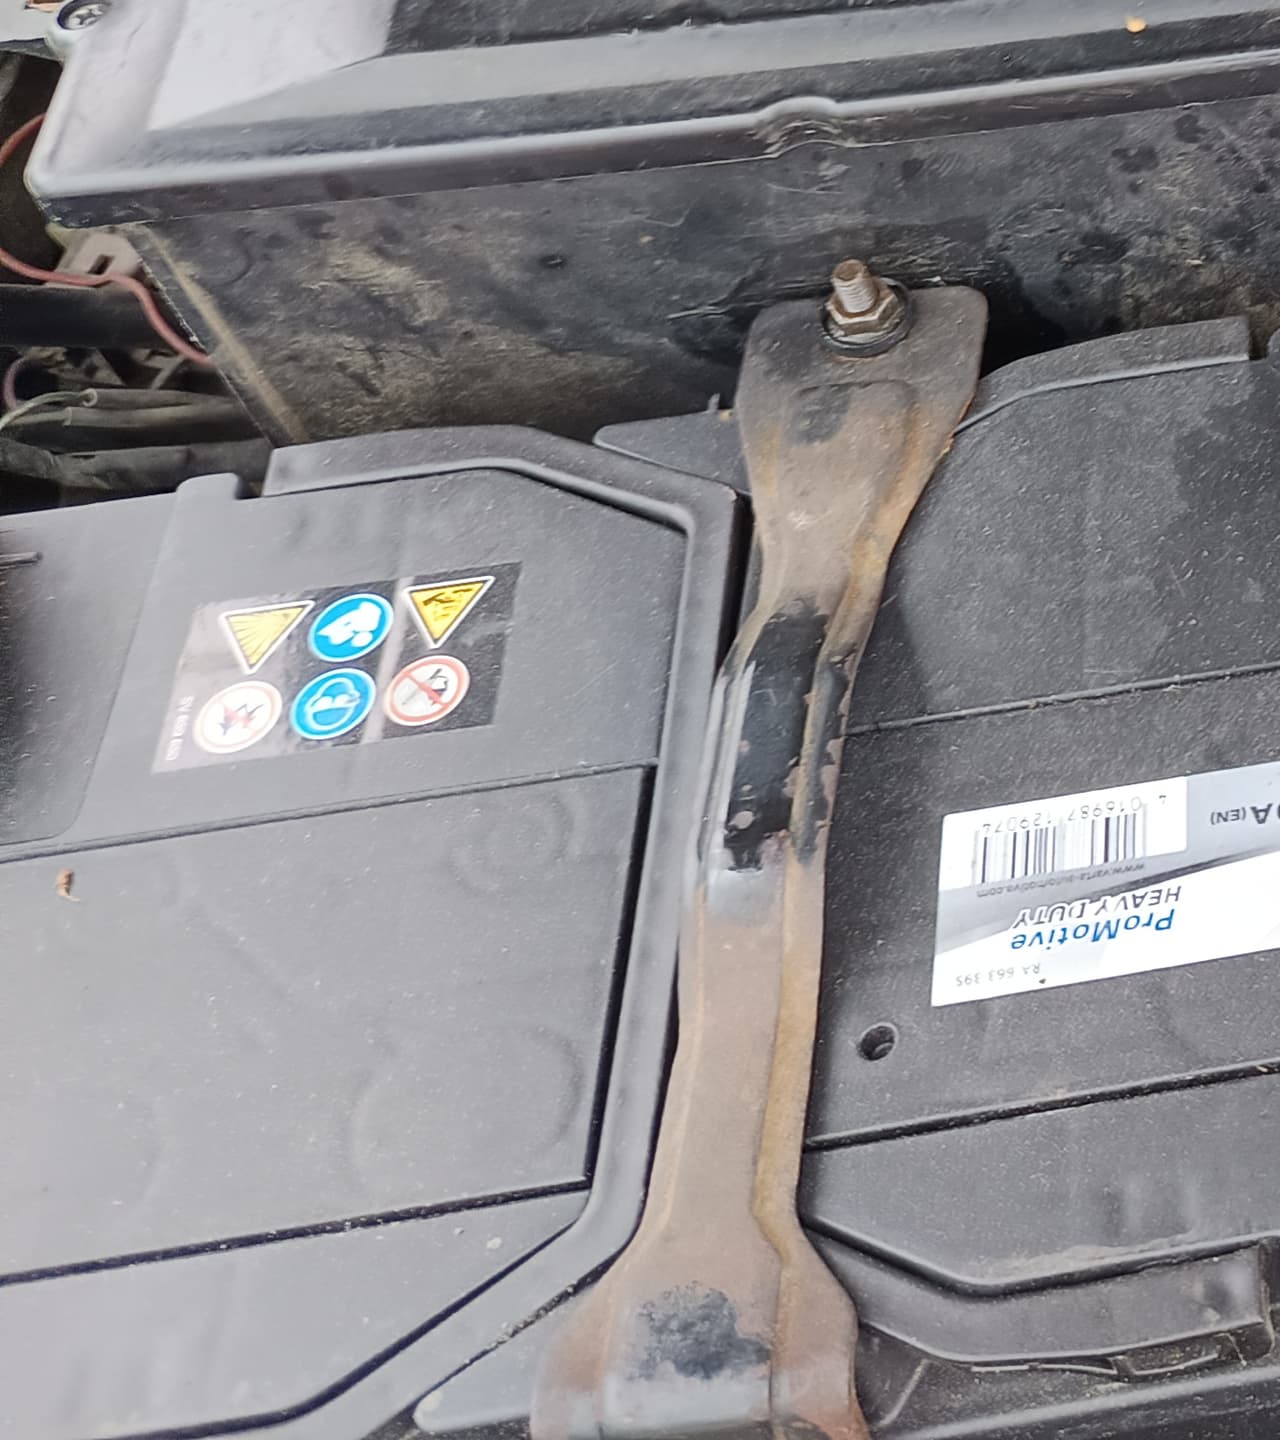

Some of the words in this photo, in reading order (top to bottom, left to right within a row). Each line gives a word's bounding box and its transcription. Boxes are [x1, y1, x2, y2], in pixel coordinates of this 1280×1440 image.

[1012, 900, 1085, 928] DUTY
[1094, 885, 1182, 917] HEAVY
[1010, 908, 1176, 950] ProMotive
